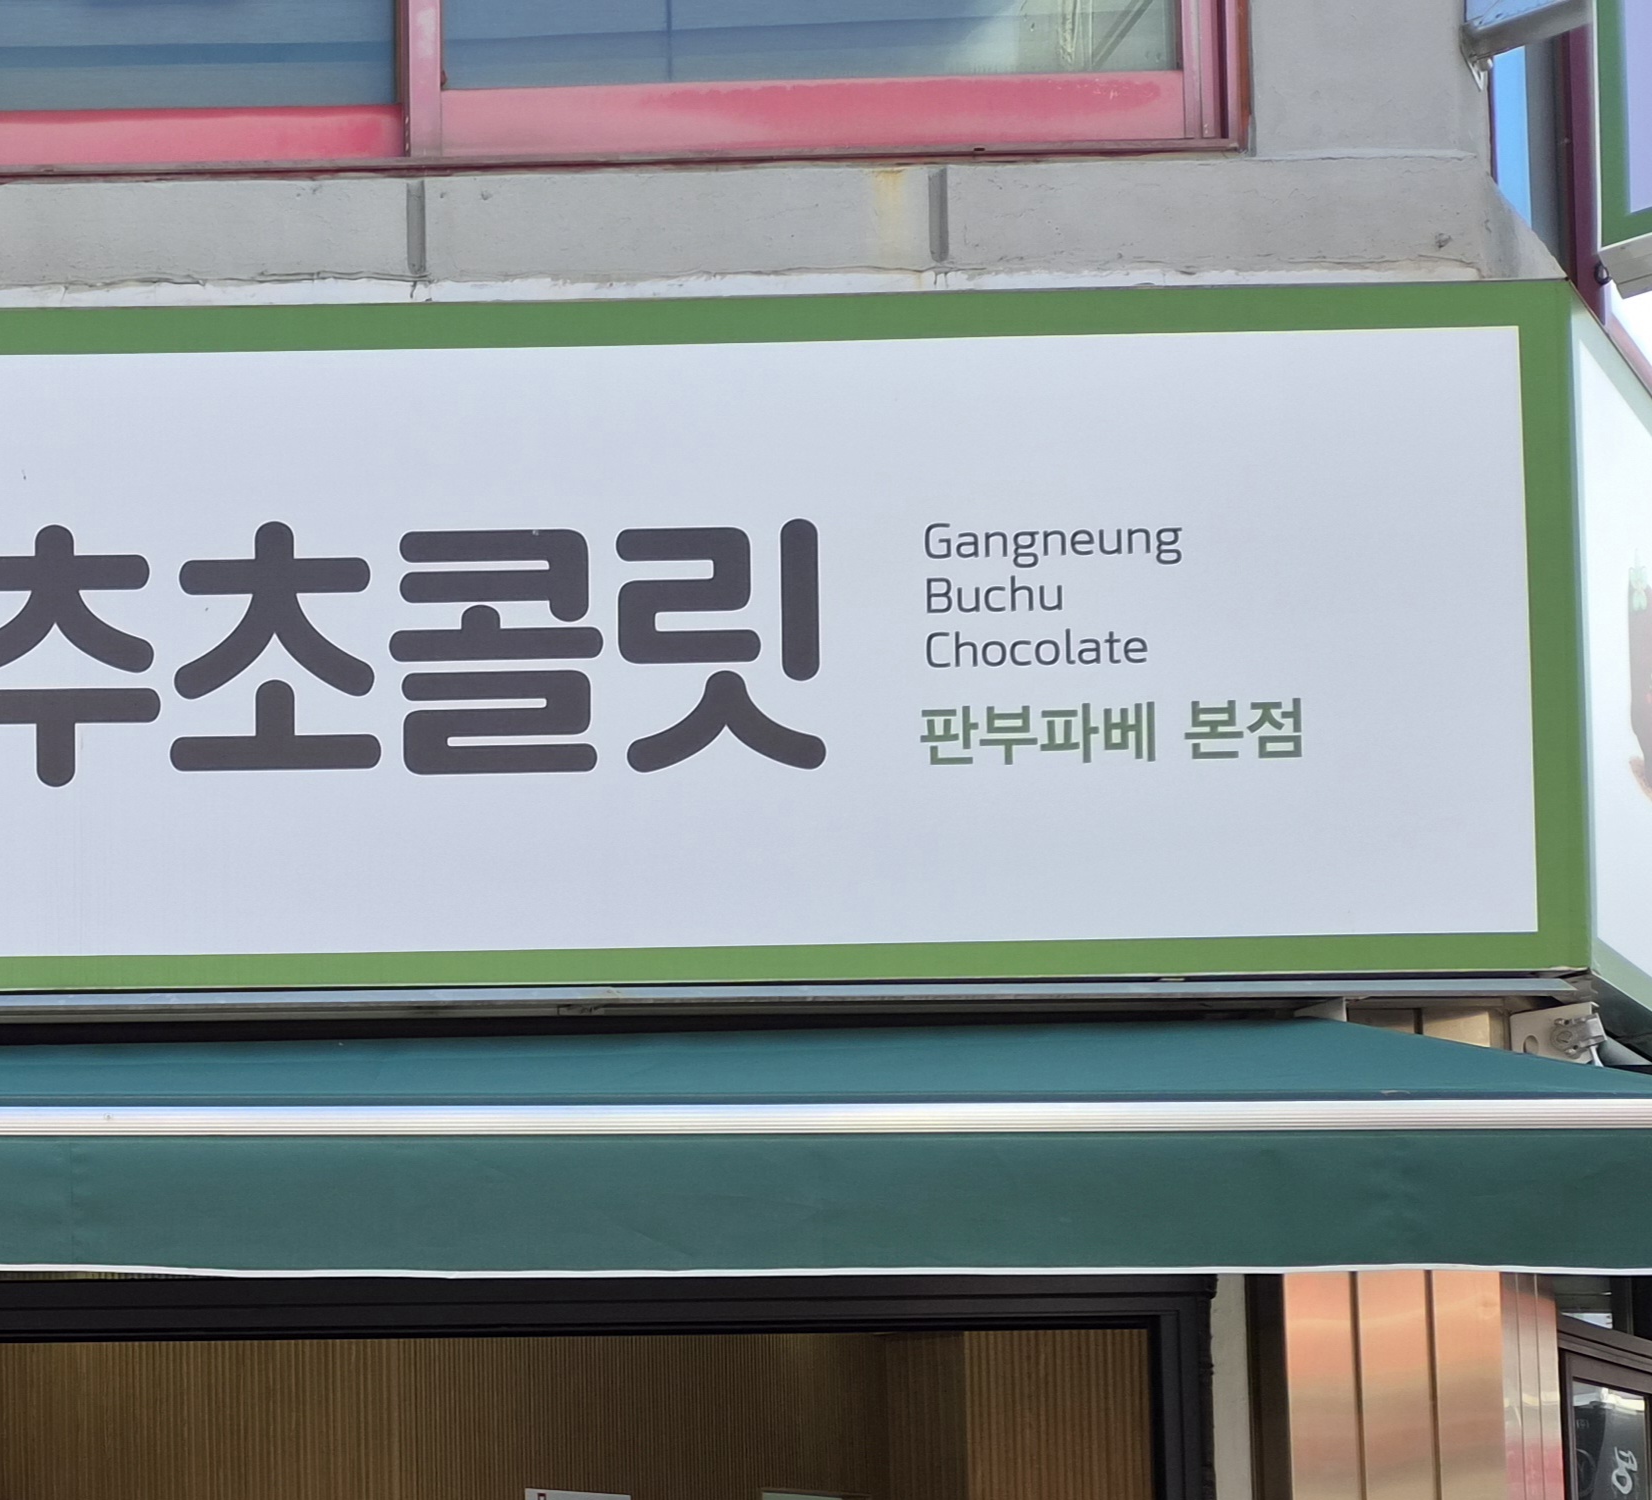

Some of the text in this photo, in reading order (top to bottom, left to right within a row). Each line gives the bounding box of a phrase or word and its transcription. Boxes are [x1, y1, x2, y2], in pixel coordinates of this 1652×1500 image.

[923, 521, 1183, 568] Gangneung
[924, 575, 1064, 614] Buchu
[924, 628, 1149, 668] Chocolate
[919, 696, 1304, 765] 판부파베 본점
